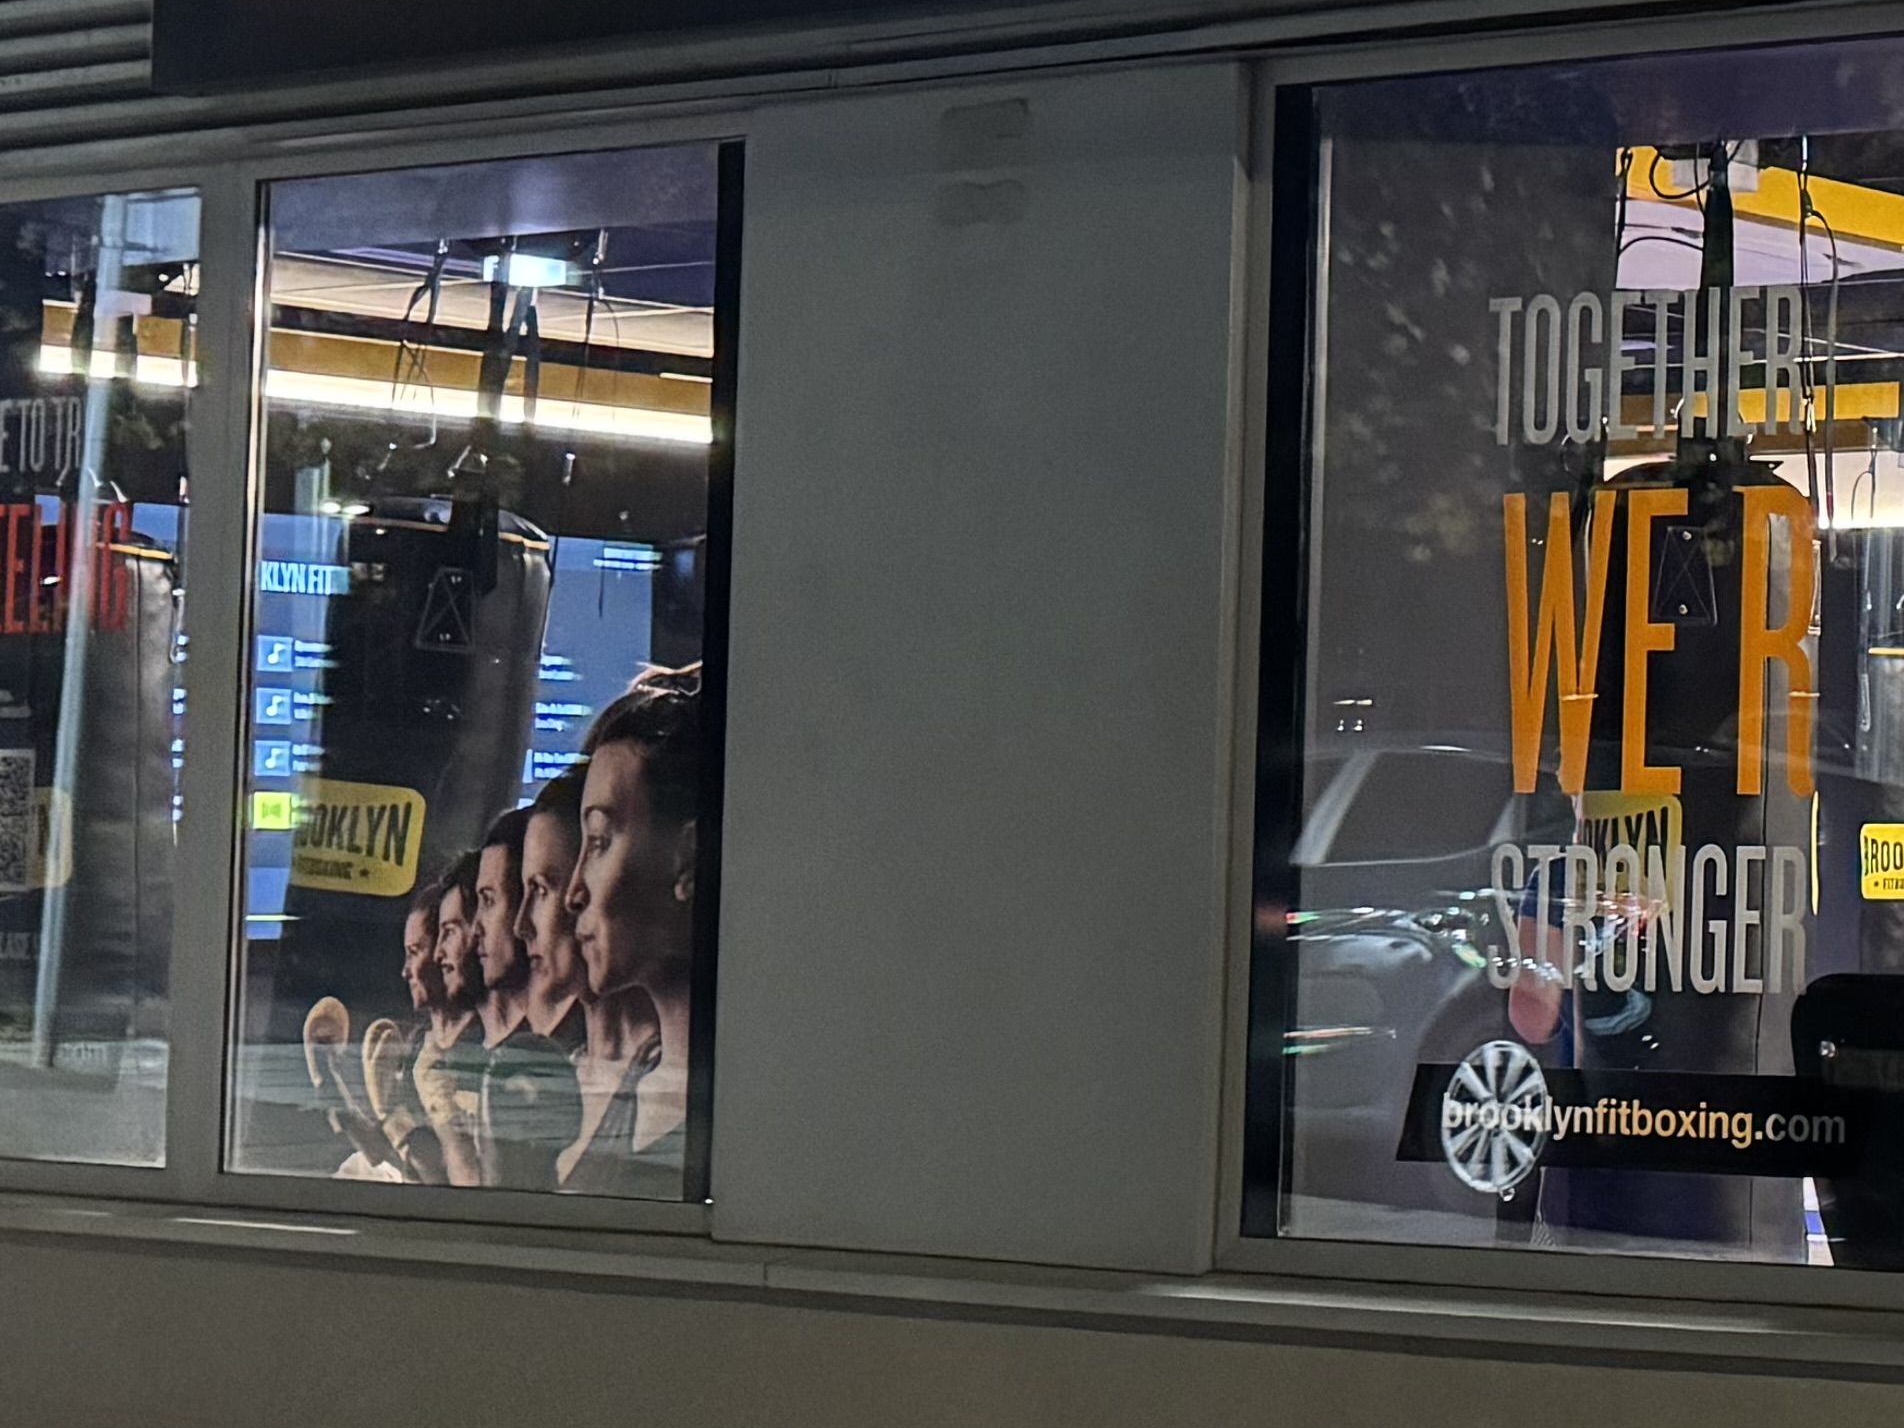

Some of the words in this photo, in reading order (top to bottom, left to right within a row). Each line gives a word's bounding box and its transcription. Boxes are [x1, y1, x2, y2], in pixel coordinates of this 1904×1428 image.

[1489, 286, 1802, 446] TOGETHER
[19, 397, 45, 473] TO
[261, 560, 305, 593] KLYN
[1502, 487, 1688, 796] WE
[1735, 485, 1817, 798] R
[1487, 842, 1808, 995] STRONGER
[1441, 1092, 1847, 1149] brooklynfitboxing.com
